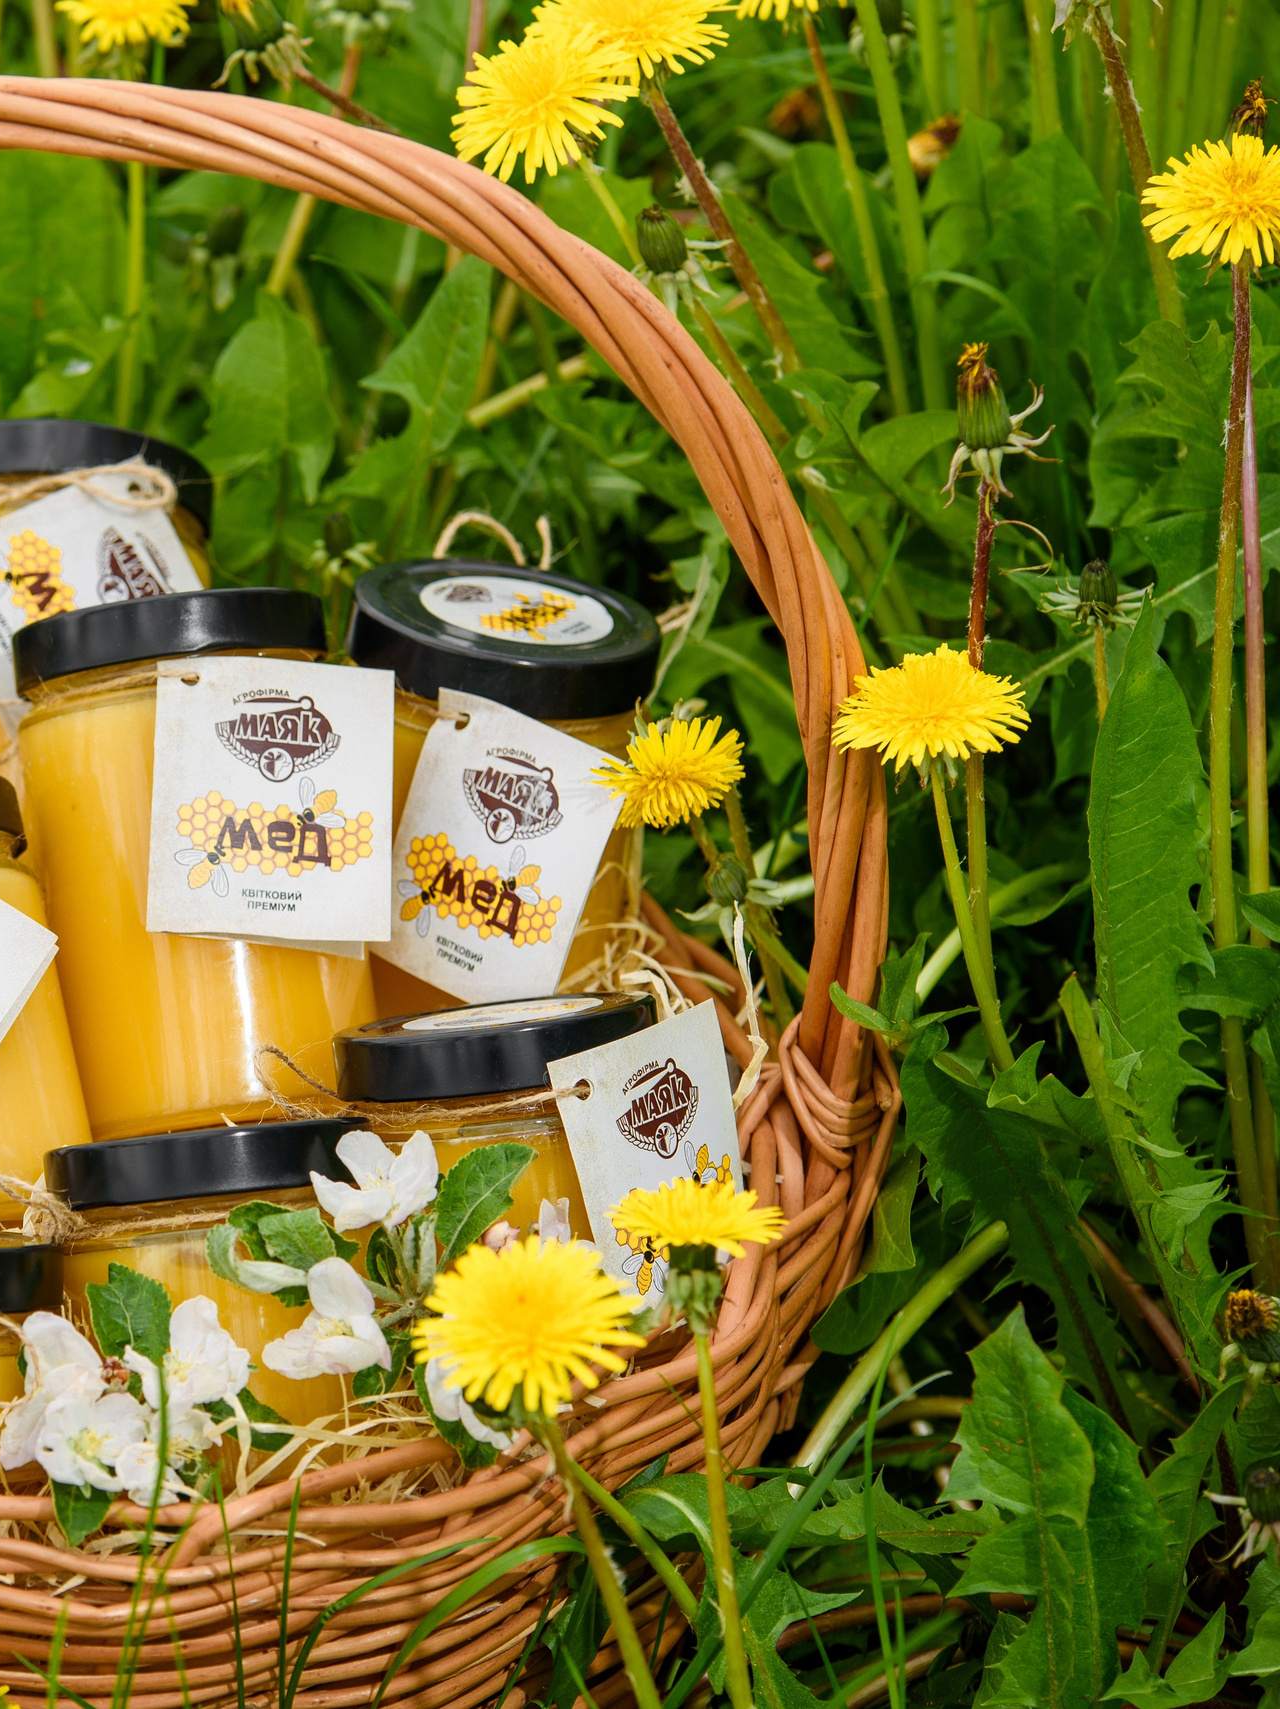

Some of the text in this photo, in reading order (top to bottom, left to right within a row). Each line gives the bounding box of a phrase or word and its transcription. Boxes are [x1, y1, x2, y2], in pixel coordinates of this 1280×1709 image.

[116, 536, 164, 599] МАЯ
[233, 688, 290, 705] АГРОФІРМА
[234, 711, 322, 746] МАЯК
[486, 747, 537, 764] АГРОФІРМА
[241, 888, 302, 900] КВІТКОВИЙ
[247, 901, 296, 912] ПРЕМІУМ
[436, 934, 483, 964] КВІТКОВИЙ
[436, 948, 476, 972] ПРЕМІУМ
[622, 1060, 660, 1095] АГРОФІРМА
[631, 1074, 688, 1128] МАЯК
